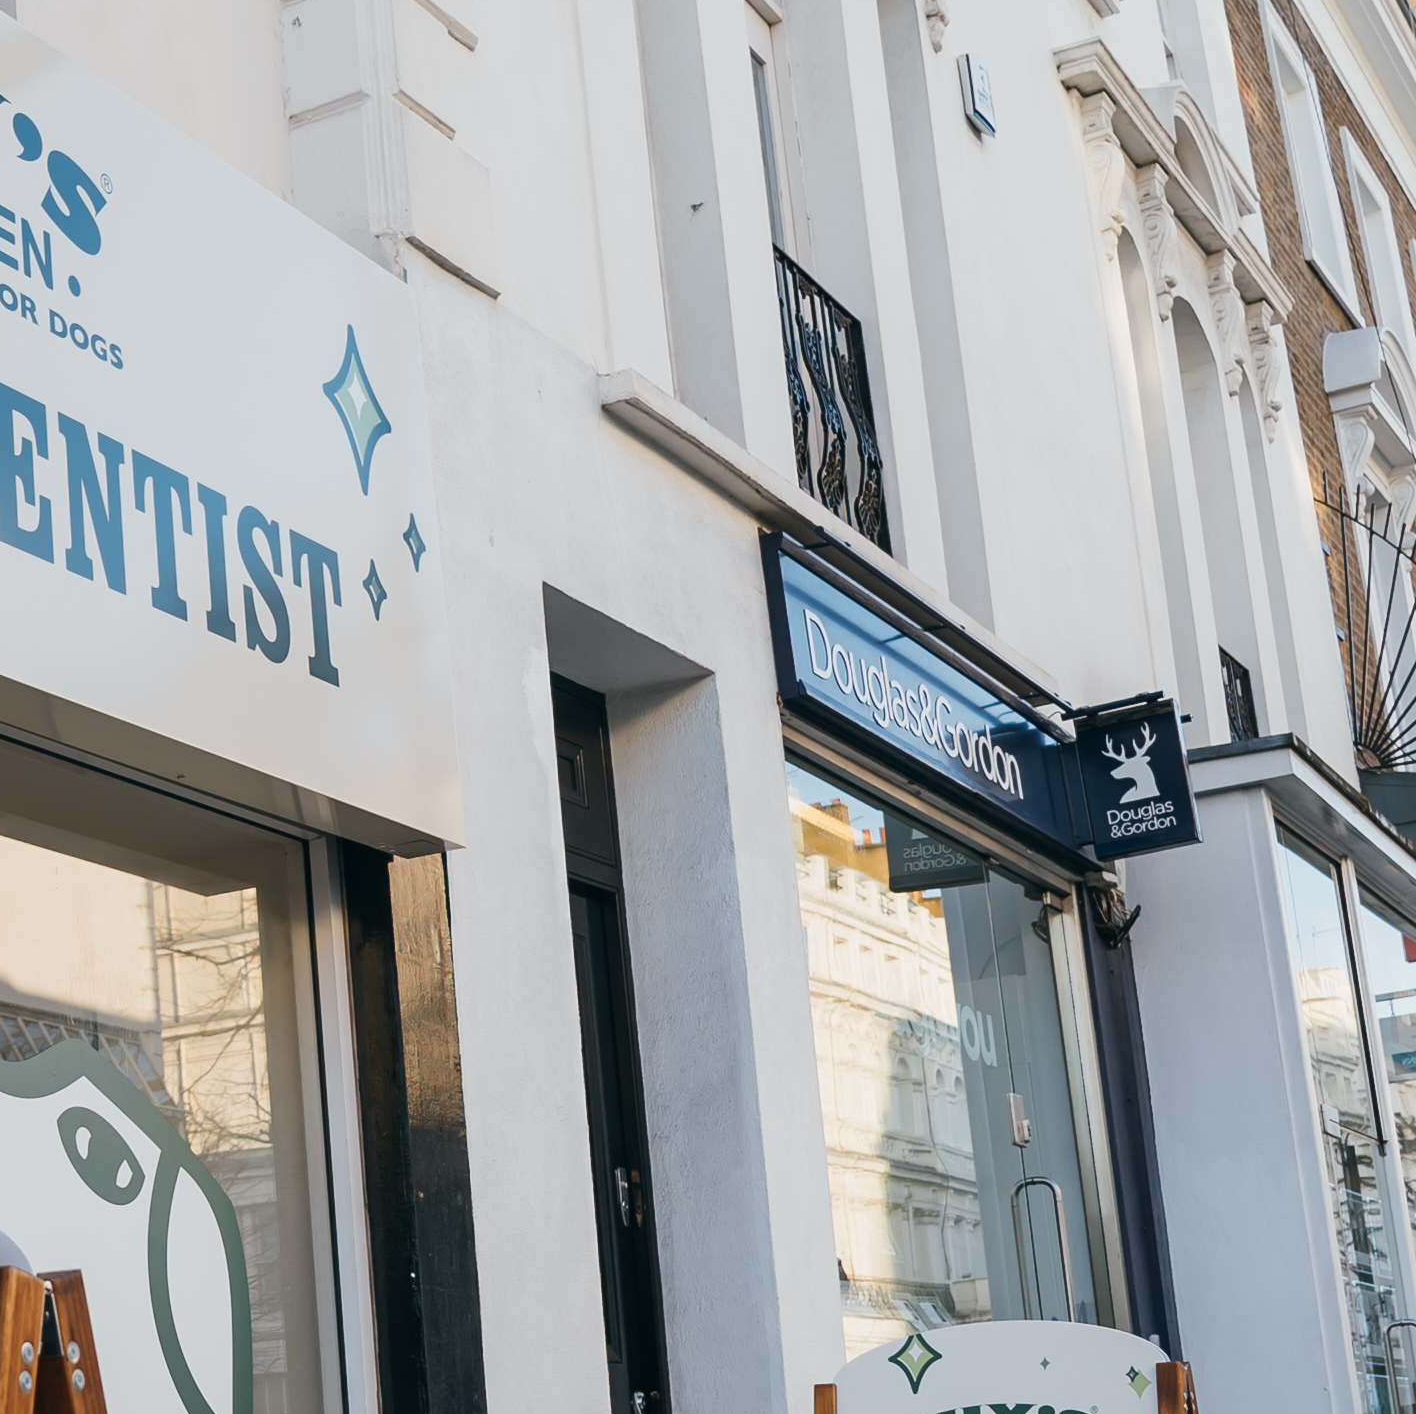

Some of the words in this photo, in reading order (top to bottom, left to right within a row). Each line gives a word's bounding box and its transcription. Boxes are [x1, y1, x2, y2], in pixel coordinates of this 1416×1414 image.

[48, 307, 126, 371] DOGS
[1106, 800, 1175, 826] Douglas
[1110, 815, 1177, 839] &Gordon
